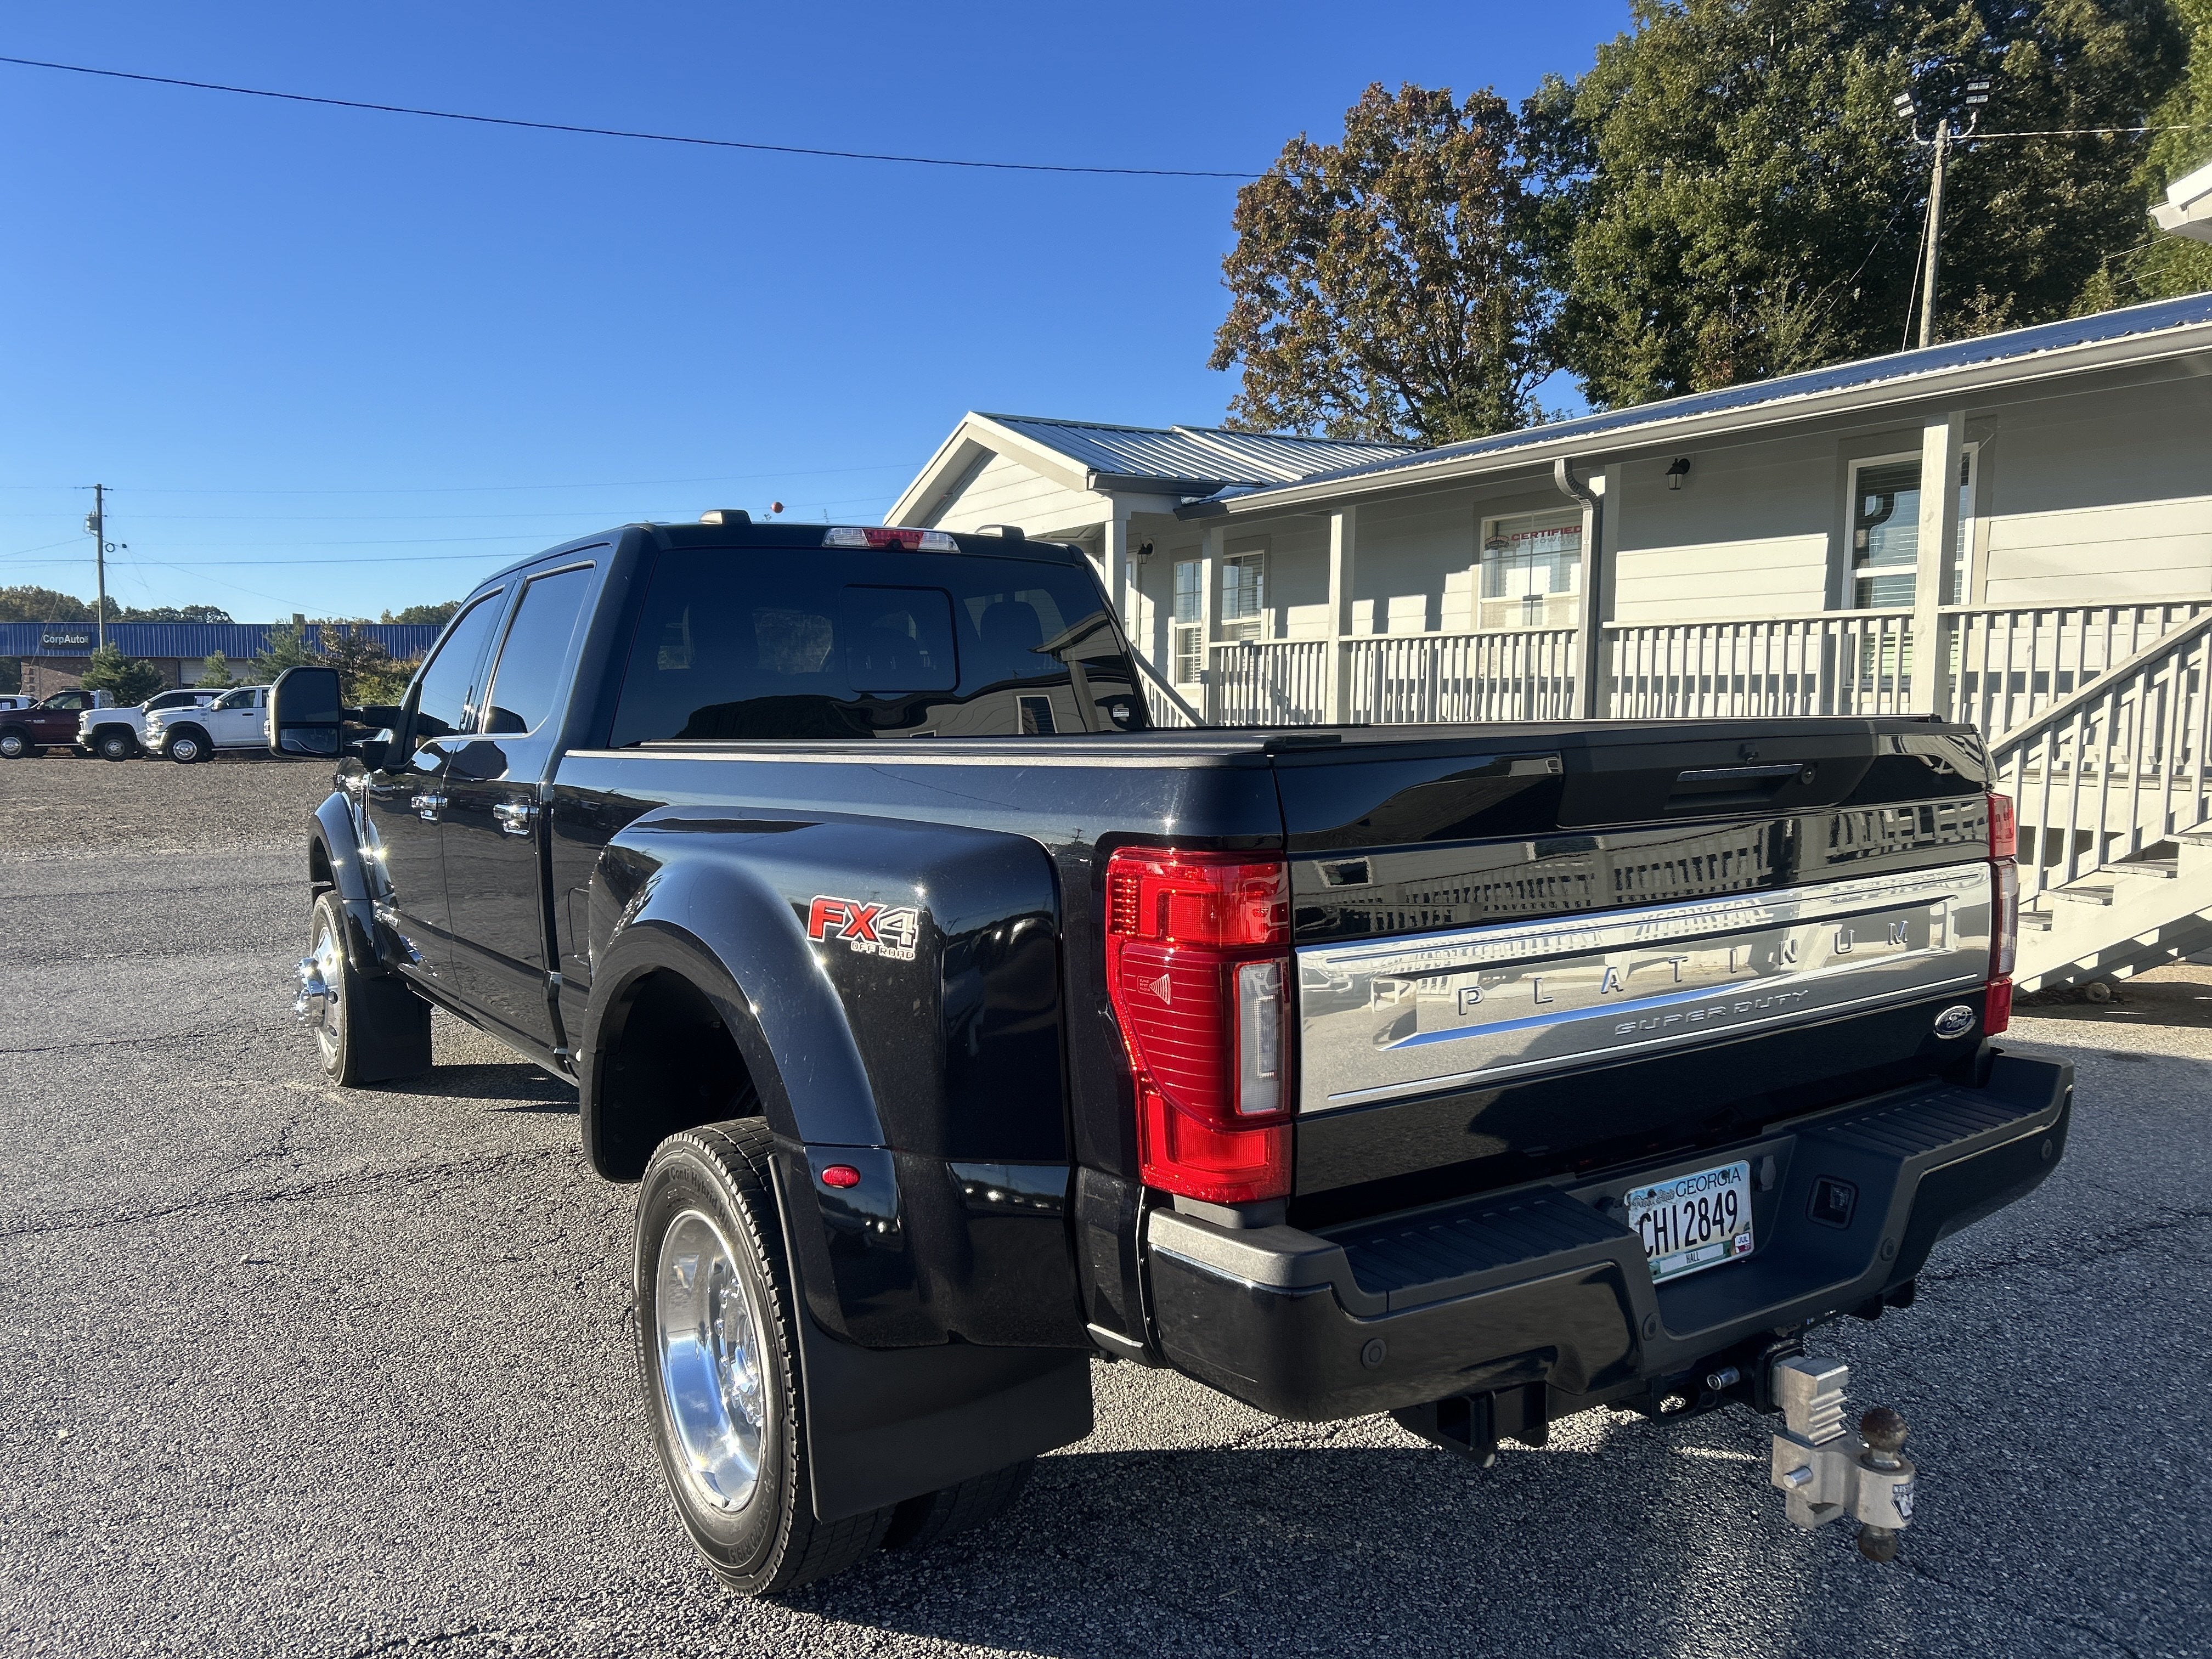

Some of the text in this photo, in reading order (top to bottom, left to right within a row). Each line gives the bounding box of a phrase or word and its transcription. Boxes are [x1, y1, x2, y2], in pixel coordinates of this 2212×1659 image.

[1511, 525, 1583, 541] CERTIFIED
[43, 634, 85, 645] CorpAuto
[806, 895, 918, 949] FX4
[851, 941, 916, 961] OFF ROAD
[1457, 920, 1910, 1015] PLATINUM
[1615, 989, 1808, 1035] SUPER DUTY
[670, 1166, 690, 1181] Conti
[691, 1171, 718, 1207] Hybrid
[1675, 1167, 1741, 1198] GEORGIA
[1639, 1189, 1738, 1259] CHI2849
[1686, 1253, 1700, 1264] HALL
